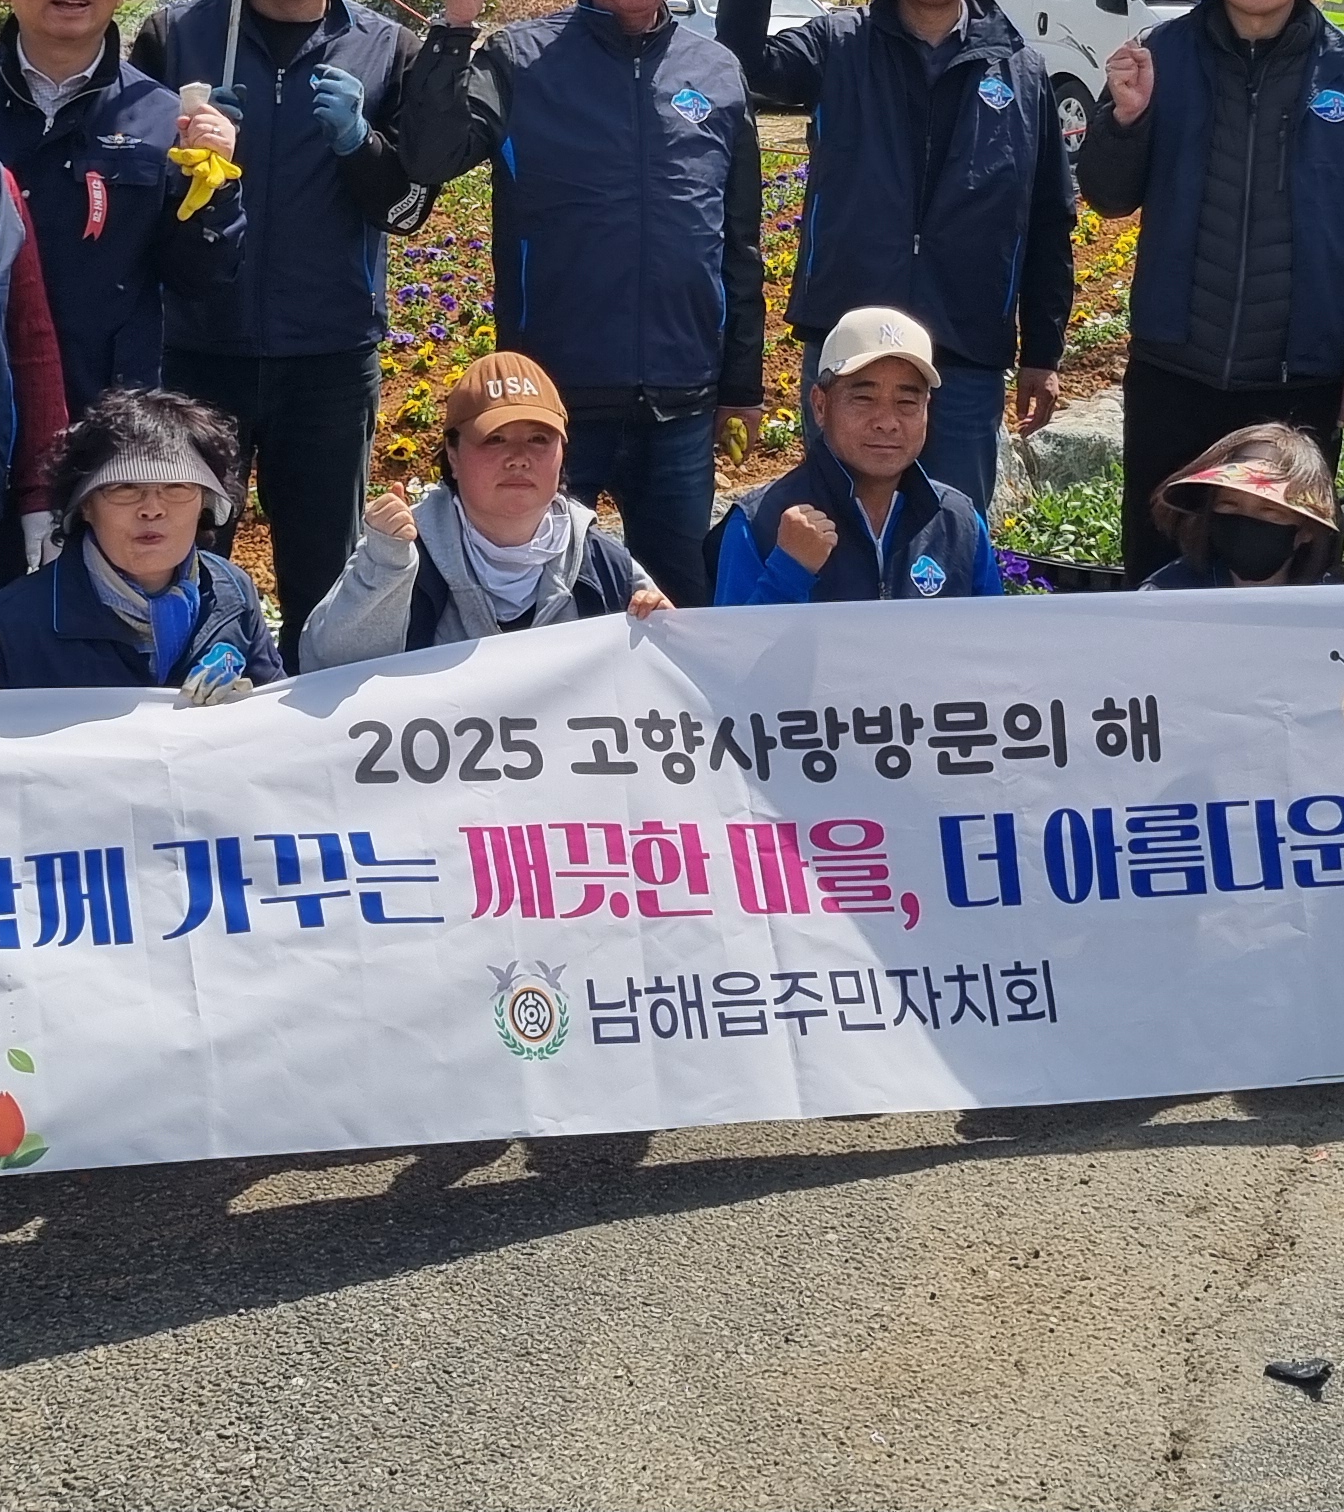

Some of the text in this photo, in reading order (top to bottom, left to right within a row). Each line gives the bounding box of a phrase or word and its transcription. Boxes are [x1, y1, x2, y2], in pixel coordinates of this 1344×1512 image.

[486, 377, 539, 399] USA
[348, 694, 1162, 785] 2025 고향사랑방문의 해
[152, 830, 446, 941] 가꾸는
[457, 817, 715, 921] 깨끗한
[726, 818, 921, 932] 마을,
[937, 812, 1023, 909] 더
[585, 958, 1059, 1045] 남해읍주민자치회
